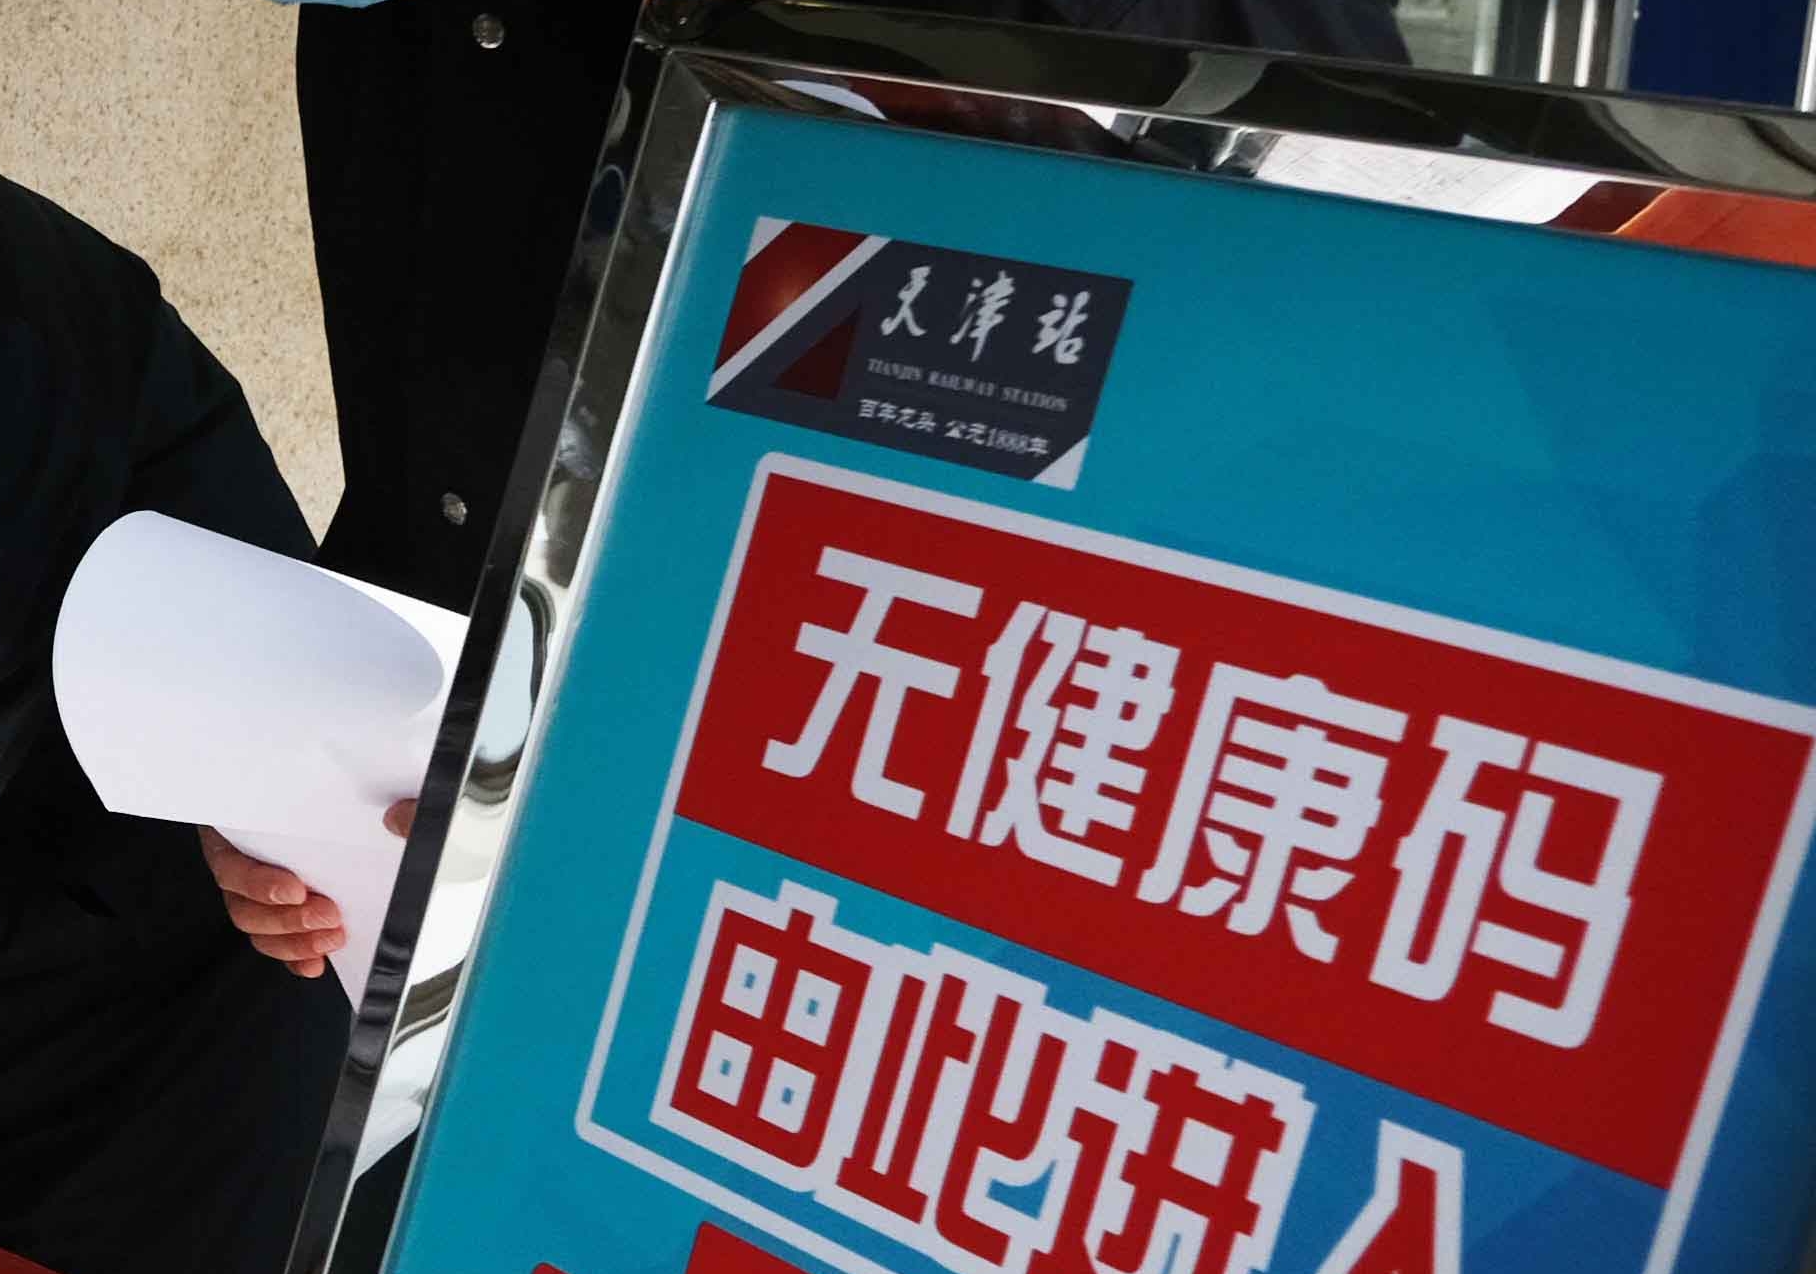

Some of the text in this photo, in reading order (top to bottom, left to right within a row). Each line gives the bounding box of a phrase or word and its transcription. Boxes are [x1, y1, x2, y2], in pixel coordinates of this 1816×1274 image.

[879, 265, 1091, 366] 天津站
[1000, 387, 1068, 412] STATION
[763, 546, 1664, 1049] 无健康码
